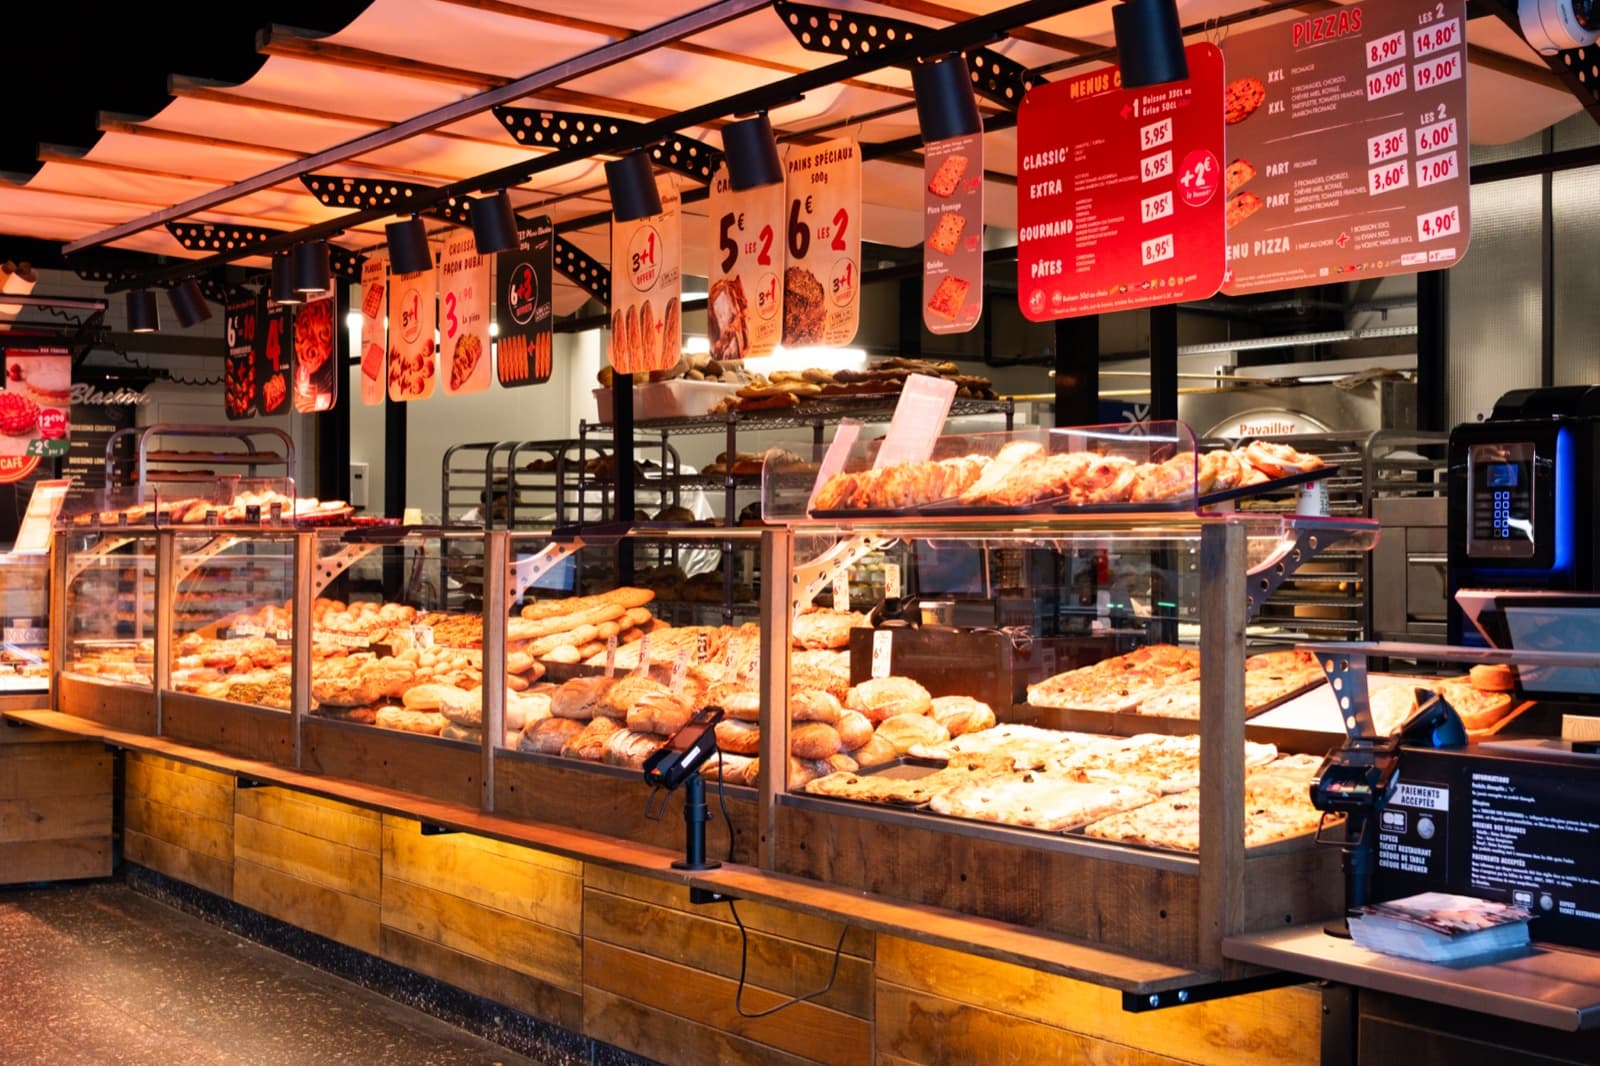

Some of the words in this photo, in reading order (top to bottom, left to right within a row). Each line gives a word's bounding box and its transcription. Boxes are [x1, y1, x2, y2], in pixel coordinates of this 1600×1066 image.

[1419, 12, 1432, 24] LES
[1436, 3, 1445, 19] 2
[1293, 8, 1362, 47] PIZZAS
[1417, 24, 1456, 52] 14,80€
[1371, 36, 1402, 62] 8,90€
[1268, 69, 1285, 83] XXL
[1369, 68, 1404, 95] 10,90€
[1417, 58, 1456, 85] 19,00€
[1070, 76, 1110, 98] MENUS
[1113, 73, 1121, 88] C
[1142, 93, 1166, 105] Boisson
[1268, 100, 1285, 114] XXL
[1421, 112, 1434, 124] LES
[1438, 104, 1446, 119] 2
[1144, 121, 1168, 145] 5,95€
[1421, 123, 1453, 149] 6,00€
[1374, 133, 1404, 158] 3,30€
[788, 158, 812, 173] PAINS
[814, 147, 853, 167] SPÉCIAUX
[1023, 147, 1069, 171] CLASSIC'
[1144, 153, 1168, 177] 6,95€
[1266, 161, 1290, 177] PART
[1422, 157, 1454, 181] 7,00€
[811, 171, 828, 185] 500g
[1180, 156, 1211, 187] +2€
[1375, 166, 1404, 190] 3,60€
[1030, 179, 1062, 199] EXTRA
[1266, 193, 1290, 208] PART
[1145, 194, 1169, 217] 7,95€
[788, 195, 813, 259] 6€
[817, 225, 830, 240] LES
[831, 208, 849, 251] 2
[1020, 219, 1073, 242] GOURMAND
[1423, 211, 1456, 236] 4,90€
[449, 239, 474, 255] CROISSA
[632, 232, 655, 272] 3+1
[720, 212, 745, 274] 5€
[745, 242, 757, 255] LES
[757, 224, 773, 266] 2
[1145, 237, 1170, 260] 8,95€
[1227, 243, 1248, 261] ENU
[1254, 236, 1290, 255] PIZZA
[443, 258, 463, 276] FAÇON
[636, 268, 655, 285] OFFERT
[832, 262, 852, 292] 3+1
[1031, 259, 1062, 278] PÂTES
[759, 277, 776, 305] 3+1
[402, 294, 419, 328] 3+1
[1239, 422, 1295, 436] Pavailler
[1, 457, 22, 469] CAFÉ
[1401, 785, 1440, 799] PAIEMENTS
[1398, 846, 1432, 857] RESTAURANT
